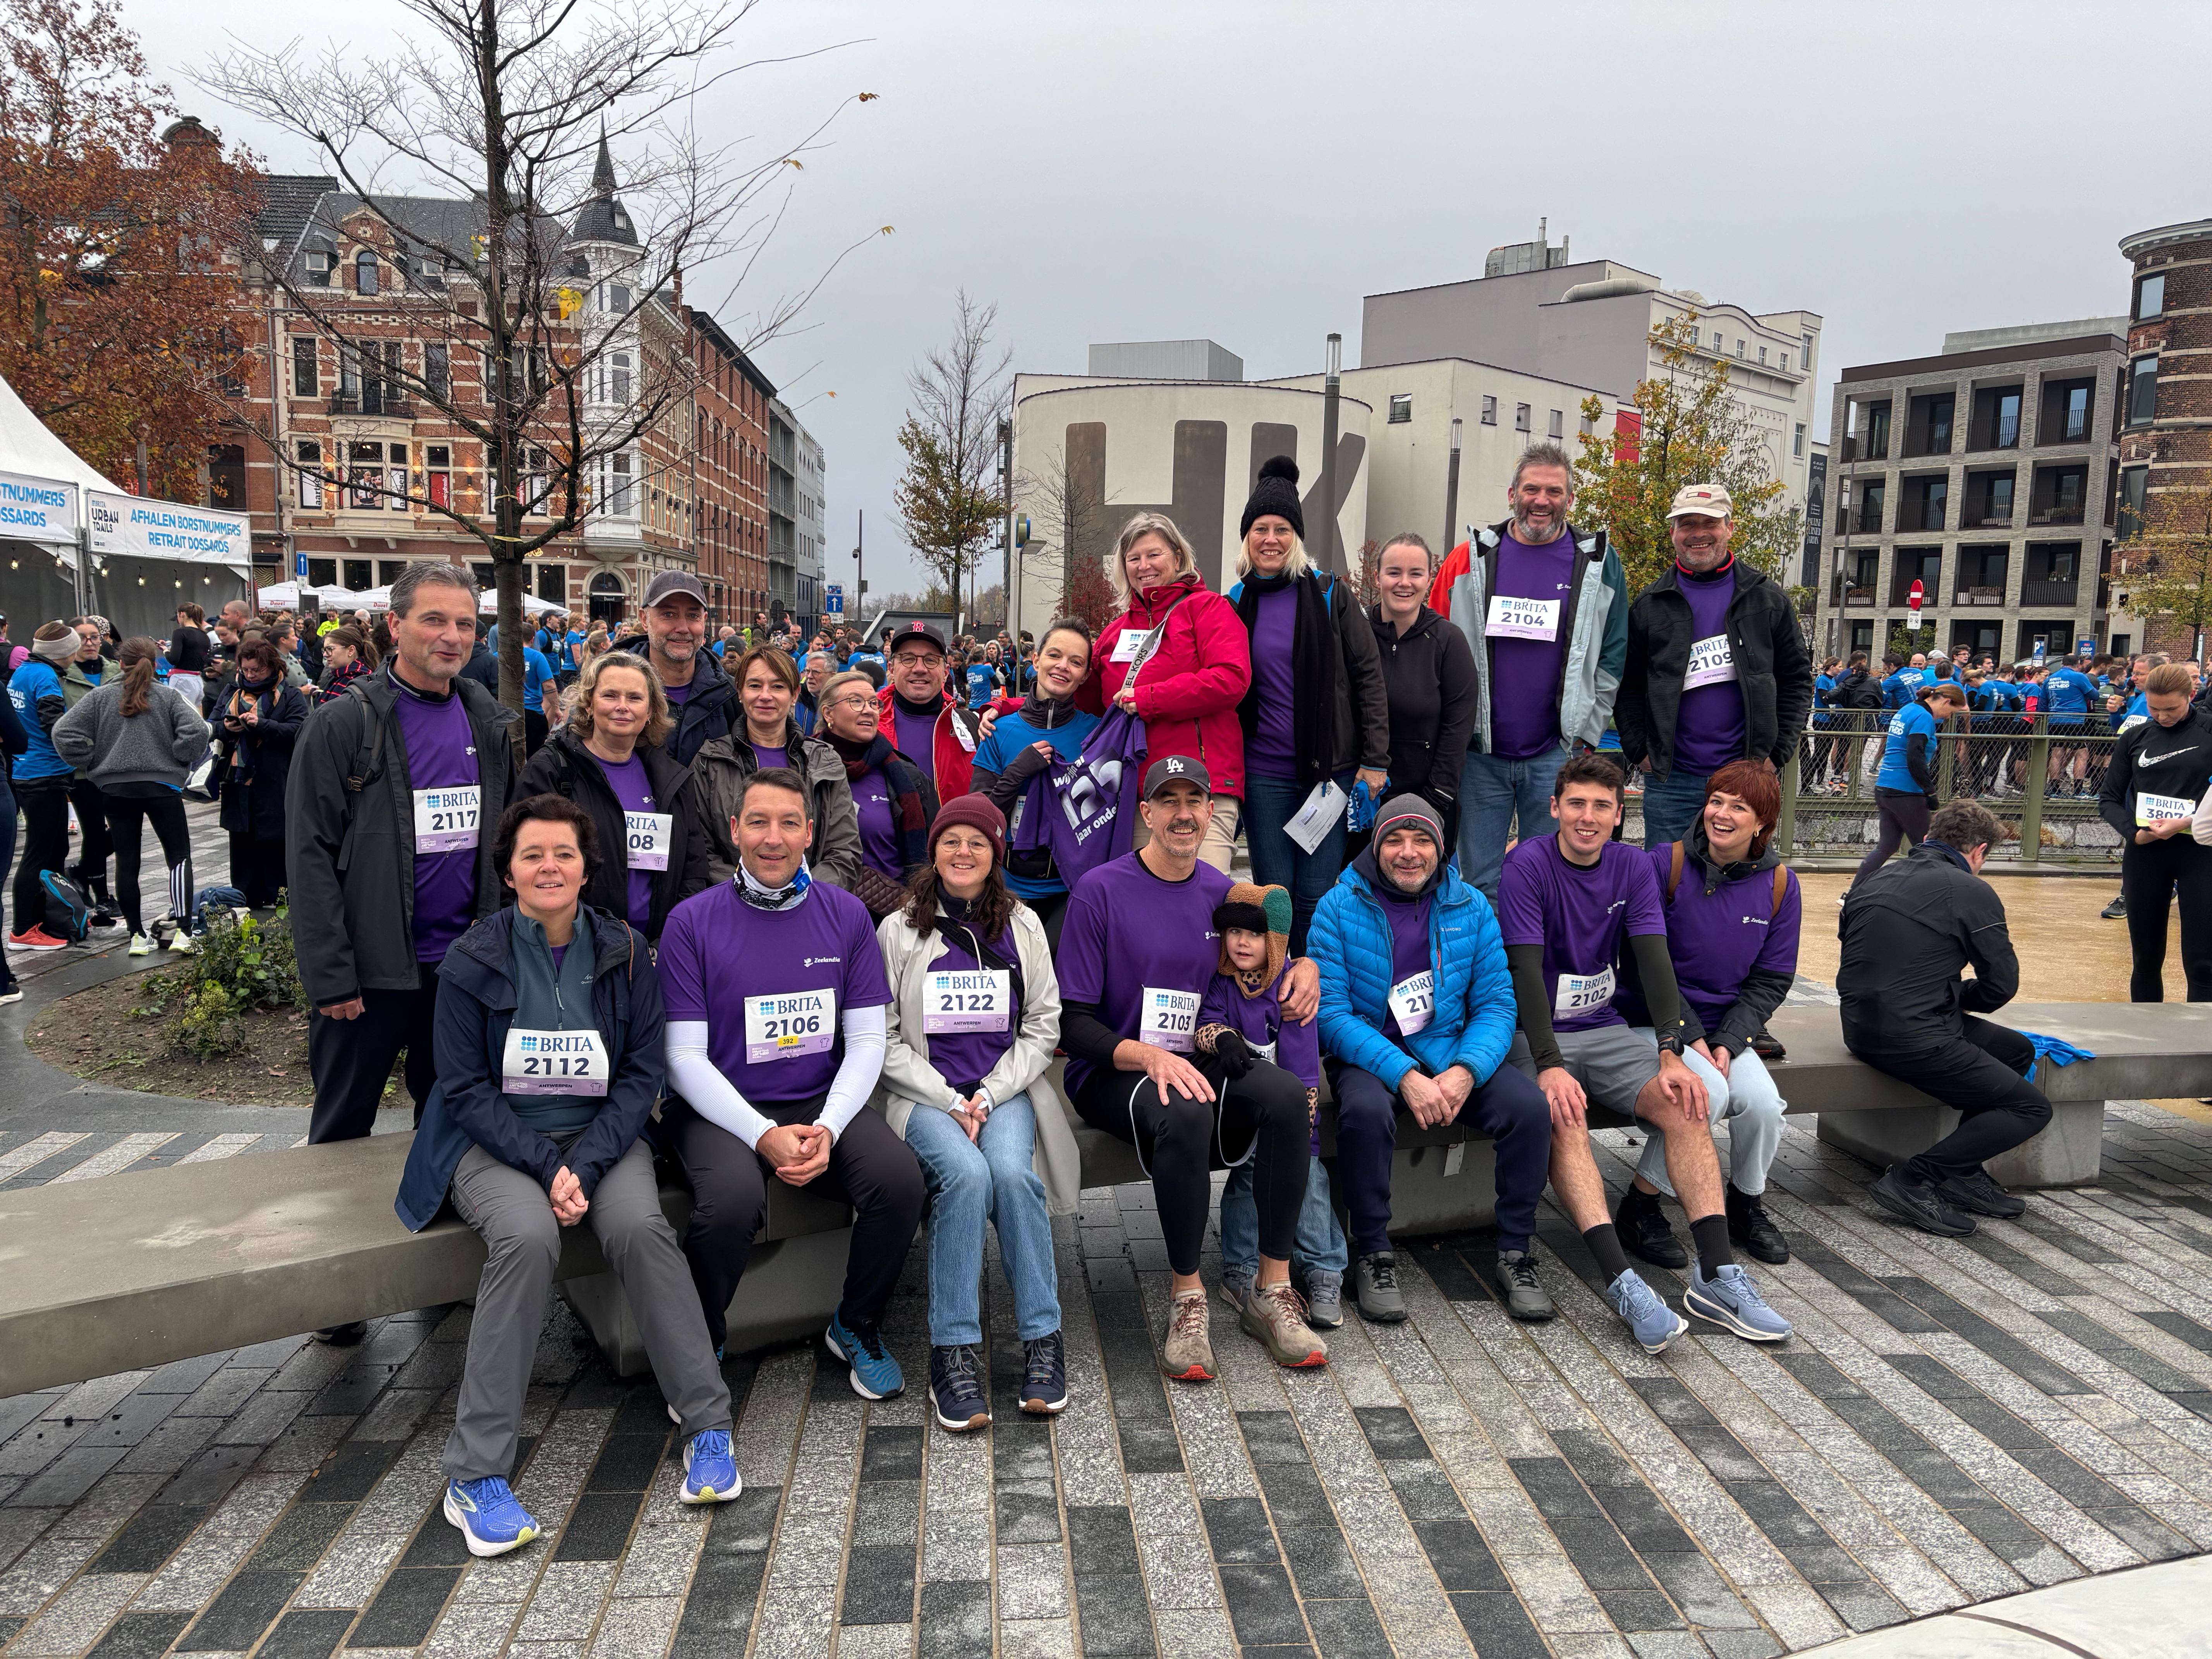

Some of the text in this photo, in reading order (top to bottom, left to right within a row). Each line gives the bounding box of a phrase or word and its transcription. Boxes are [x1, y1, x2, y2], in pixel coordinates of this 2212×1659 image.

[0, 483, 65, 507] TNUMMERS
[0, 507, 46, 527] SSARDS
[91, 507, 119, 524] URBAN
[130, 509, 241, 536] AFHALEN BORSTNUMMERS
[93, 522, 113, 533] TRAILS
[148, 531, 229, 553] RETRAIT DOSSARDS
[1513, 601, 1548, 613] BRITA
[911, 620, 925, 632] B
[1501, 612, 1545, 626] 2104
[1695, 638, 1729, 656] BRITA
[1130, 648, 1148, 672] KORS
[1689, 651, 1734, 673] 2109
[1074, 755, 1085, 768] al
[1166, 757, 1184, 773] LA
[442, 792, 479, 807] BRITA
[2156, 798, 2185, 811] BRITA
[431, 810, 477, 831] 2117
[2146, 808, 2183, 819] 3807
[626, 816, 658, 831] RITA
[1075, 803, 1118, 847] jaar onde
[629, 834, 654, 850] 08
[951, 975, 998, 989] BRITA
[1408, 975, 1434, 992] BRI
[1583, 972, 1610, 991] BRITA
[777, 996, 823, 1015] BRITA
[940, 994, 994, 1011] 2122
[1170, 995, 1195, 1011] BRITA
[1405, 992, 1434, 1013] 21
[1570, 987, 1607, 1007] 2102
[764, 1015, 820, 1039] 2106
[1158, 1012, 1192, 1032] 2103
[539, 1036, 594, 1052] BRITA
[524, 1057, 589, 1075] 2112
